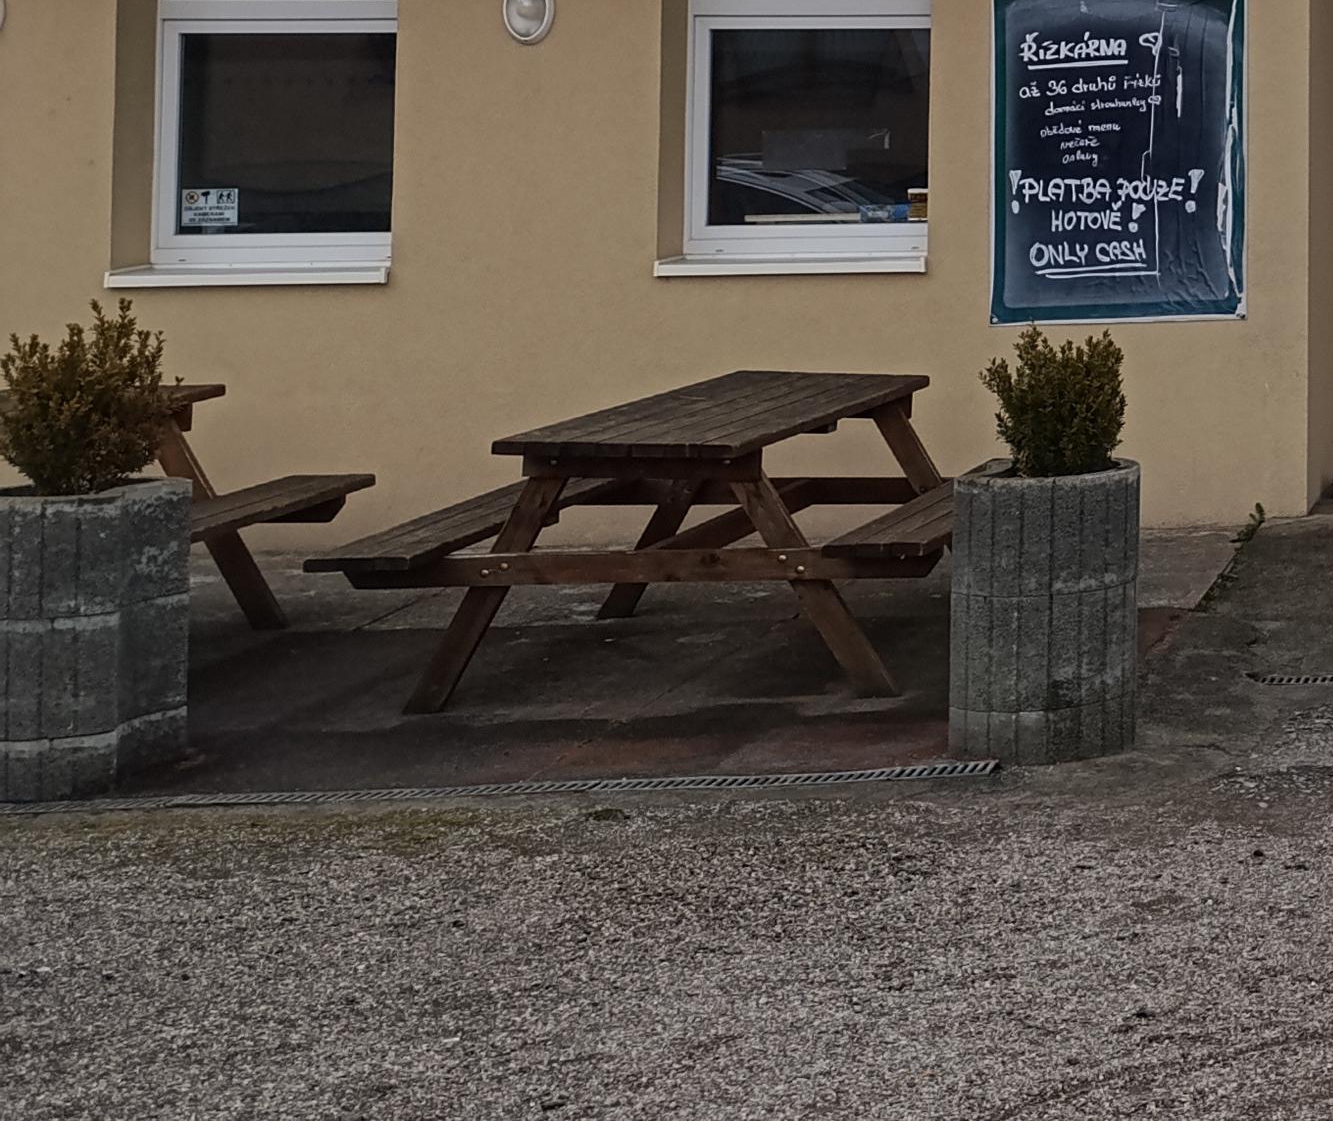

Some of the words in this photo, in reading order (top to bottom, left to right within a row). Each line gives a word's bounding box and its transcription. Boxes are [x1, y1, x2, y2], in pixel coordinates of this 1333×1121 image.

[1019, 81, 1041, 99] až
[1046, 80, 1068, 96] 36
[1071, 75, 1117, 94] druhů
[1088, 122, 1121, 133] menu
[1029, 240, 1088, 267] ONLY
[1095, 238, 1147, 262] CASH
